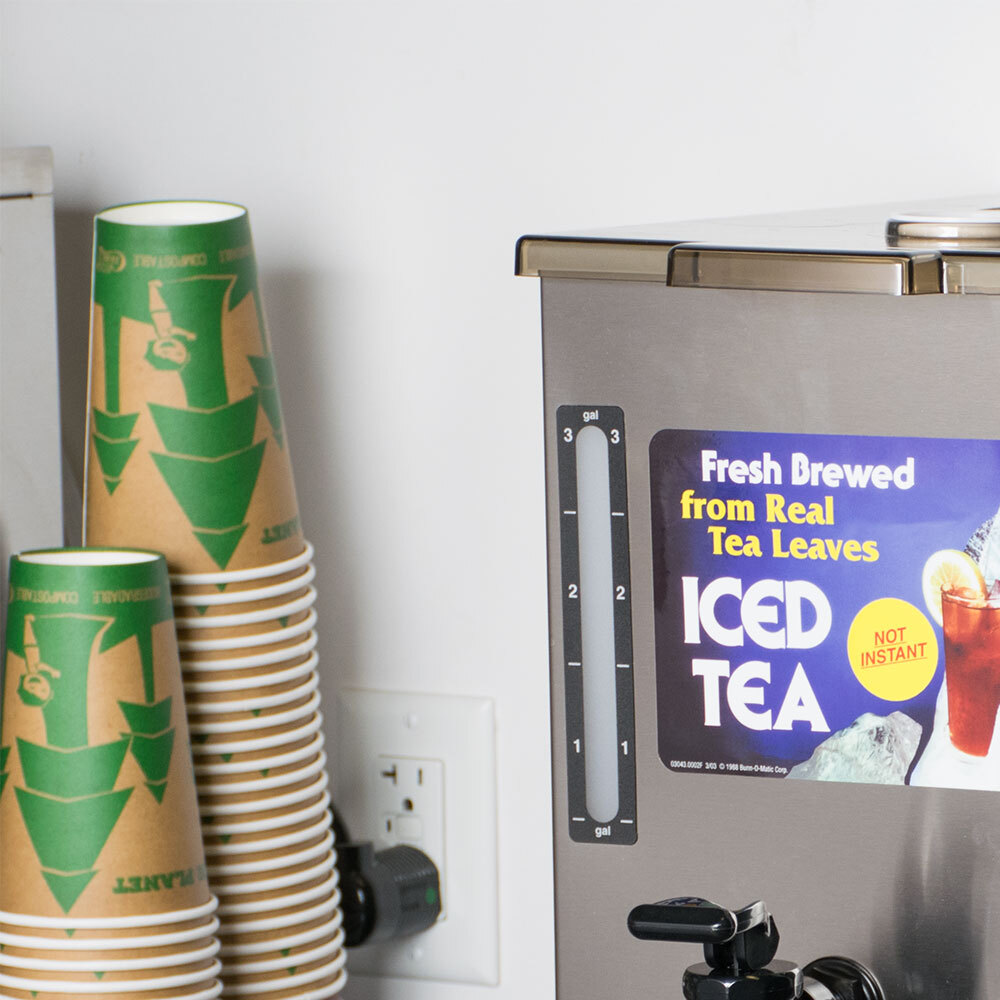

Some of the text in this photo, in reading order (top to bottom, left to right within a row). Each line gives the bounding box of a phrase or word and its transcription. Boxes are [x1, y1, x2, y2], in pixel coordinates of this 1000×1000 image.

[583, 409, 599, 422] gal
[563, 428, 620, 444] 3 3
[701, 449, 915, 490] Fresh Brewed
[680, 489, 835, 525] from Real
[708, 526, 880, 563] Tea Leaves
[568, 584, 626, 600] 2 2
[682, 576, 833, 650] ICED
[874, 626, 907, 646] NOT
[860, 641, 928, 668] INSTANT
[692, 658, 831, 732] TEA
[573, 739, 628, 755] 1 1
[740, 763, 774, 773] Bunn-O-Matic
[775, 766, 789, 775] Corp.
[595, 824, 611, 838] gal
[112, 868, 195, 895] PLANET
